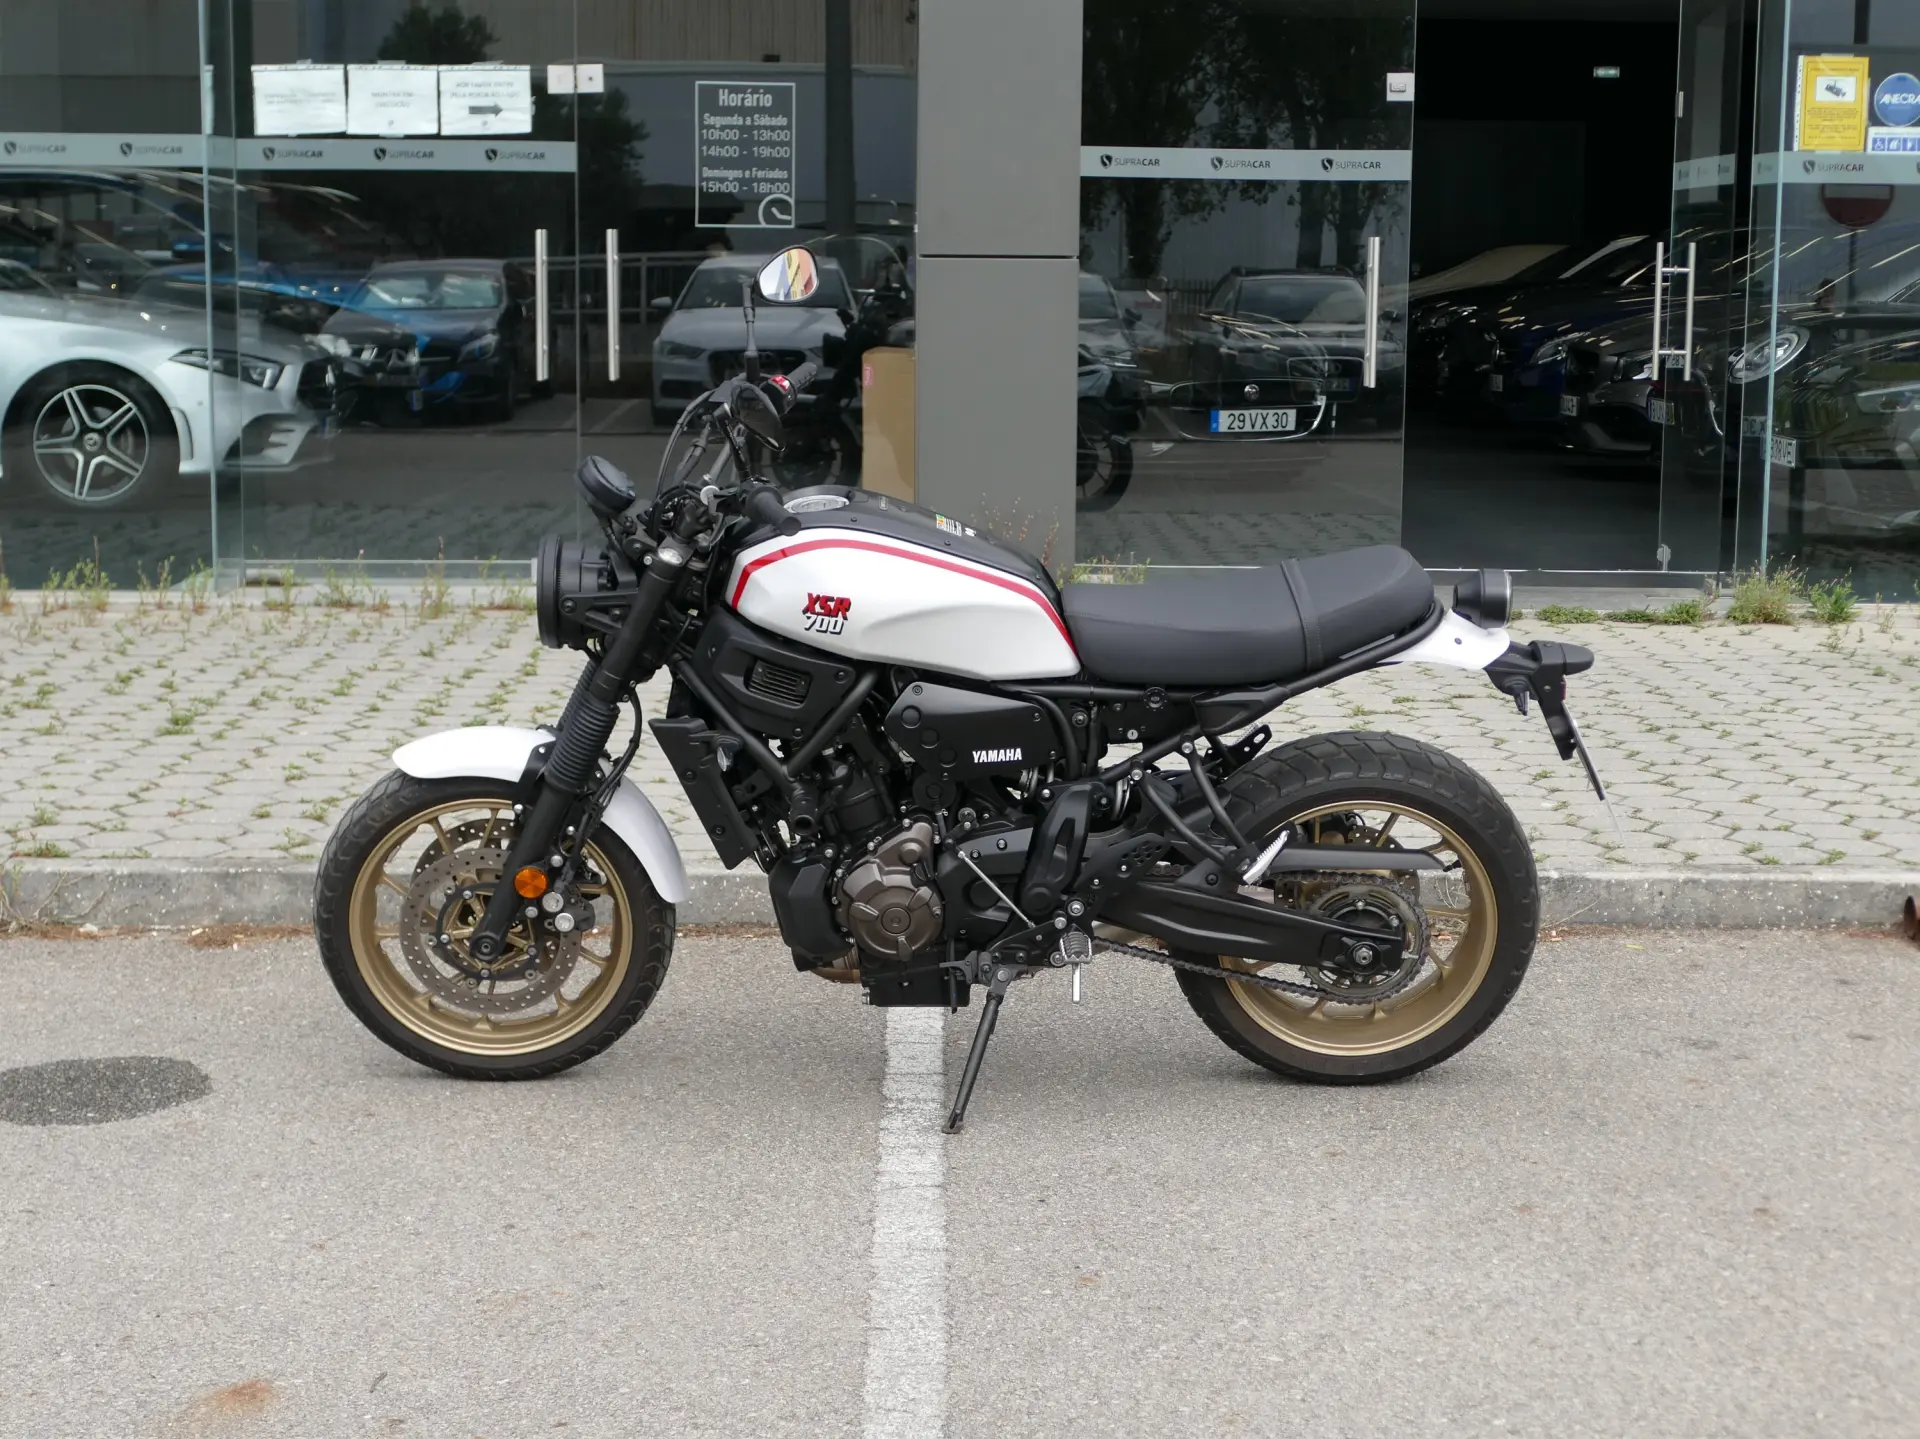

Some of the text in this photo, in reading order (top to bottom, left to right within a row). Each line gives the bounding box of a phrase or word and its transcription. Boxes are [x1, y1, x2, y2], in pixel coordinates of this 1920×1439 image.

[718, 88, 773, 107] Horário
[703, 113, 788, 128] Segunda a Sábado
[701, 129, 740, 140] 10h00
[752, 129, 790, 141] 13h00
[701, 145, 740, 157] 14h00
[752, 146, 790, 158] 19h00
[1114, 157, 1160, 167] SUPRACAR
[1225, 159, 1271, 169] SUPRACAR
[1335, 160, 1382, 170] SUPRACAR
[1817, 163, 1865, 172] SUPRACAR
[702, 166, 789, 181] Domingos e Feriados
[701, 181, 740, 193] 15h00
[752, 182, 790, 193] 18h00
[802, 592, 851, 620] XSR
[804, 614, 845, 635] 700
[972, 747, 1023, 764] YAMAHA
